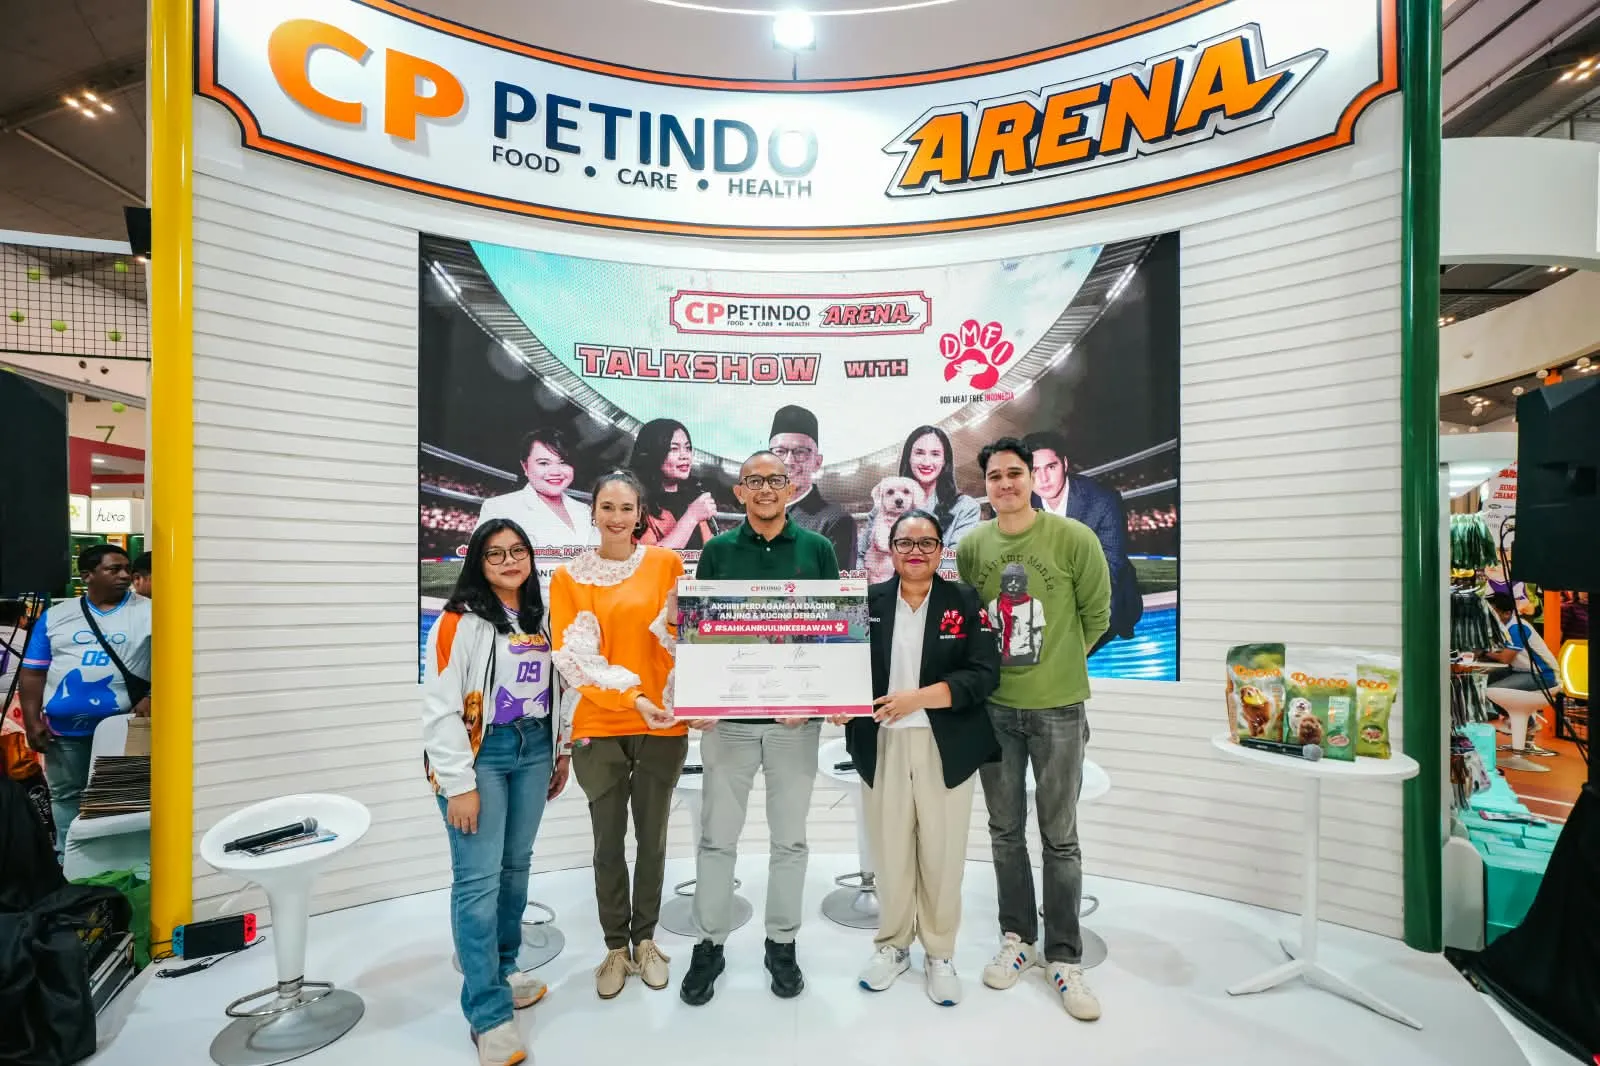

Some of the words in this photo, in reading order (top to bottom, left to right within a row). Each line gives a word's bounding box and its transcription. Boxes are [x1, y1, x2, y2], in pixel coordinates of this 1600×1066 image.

[268, 18, 465, 141] CP
[493, 80, 819, 178] PETINDO
[898, 34, 1292, 188] ARENA
[492, 145, 561, 174] FOOD
[617, 168, 678, 190] CARE
[728, 178, 813, 198] HEALTH
[684, 302, 725, 324] CP
[727, 304, 811, 321] PETINDO
[821, 302, 917, 327] ARENA
[576, 344, 819, 384] TALKSHOW
[844, 359, 909, 378] WITH
[953, 395, 967, 404] MEAT
[970, 394, 984, 402] FREE
[985, 391, 1015, 402] INDONESIA
[711, 602, 739, 610] AKHIRI
[740, 602, 803, 610] PERDAGANGAN
[804, 602, 836, 610] DAGING
[516, 661, 542, 683] 09
